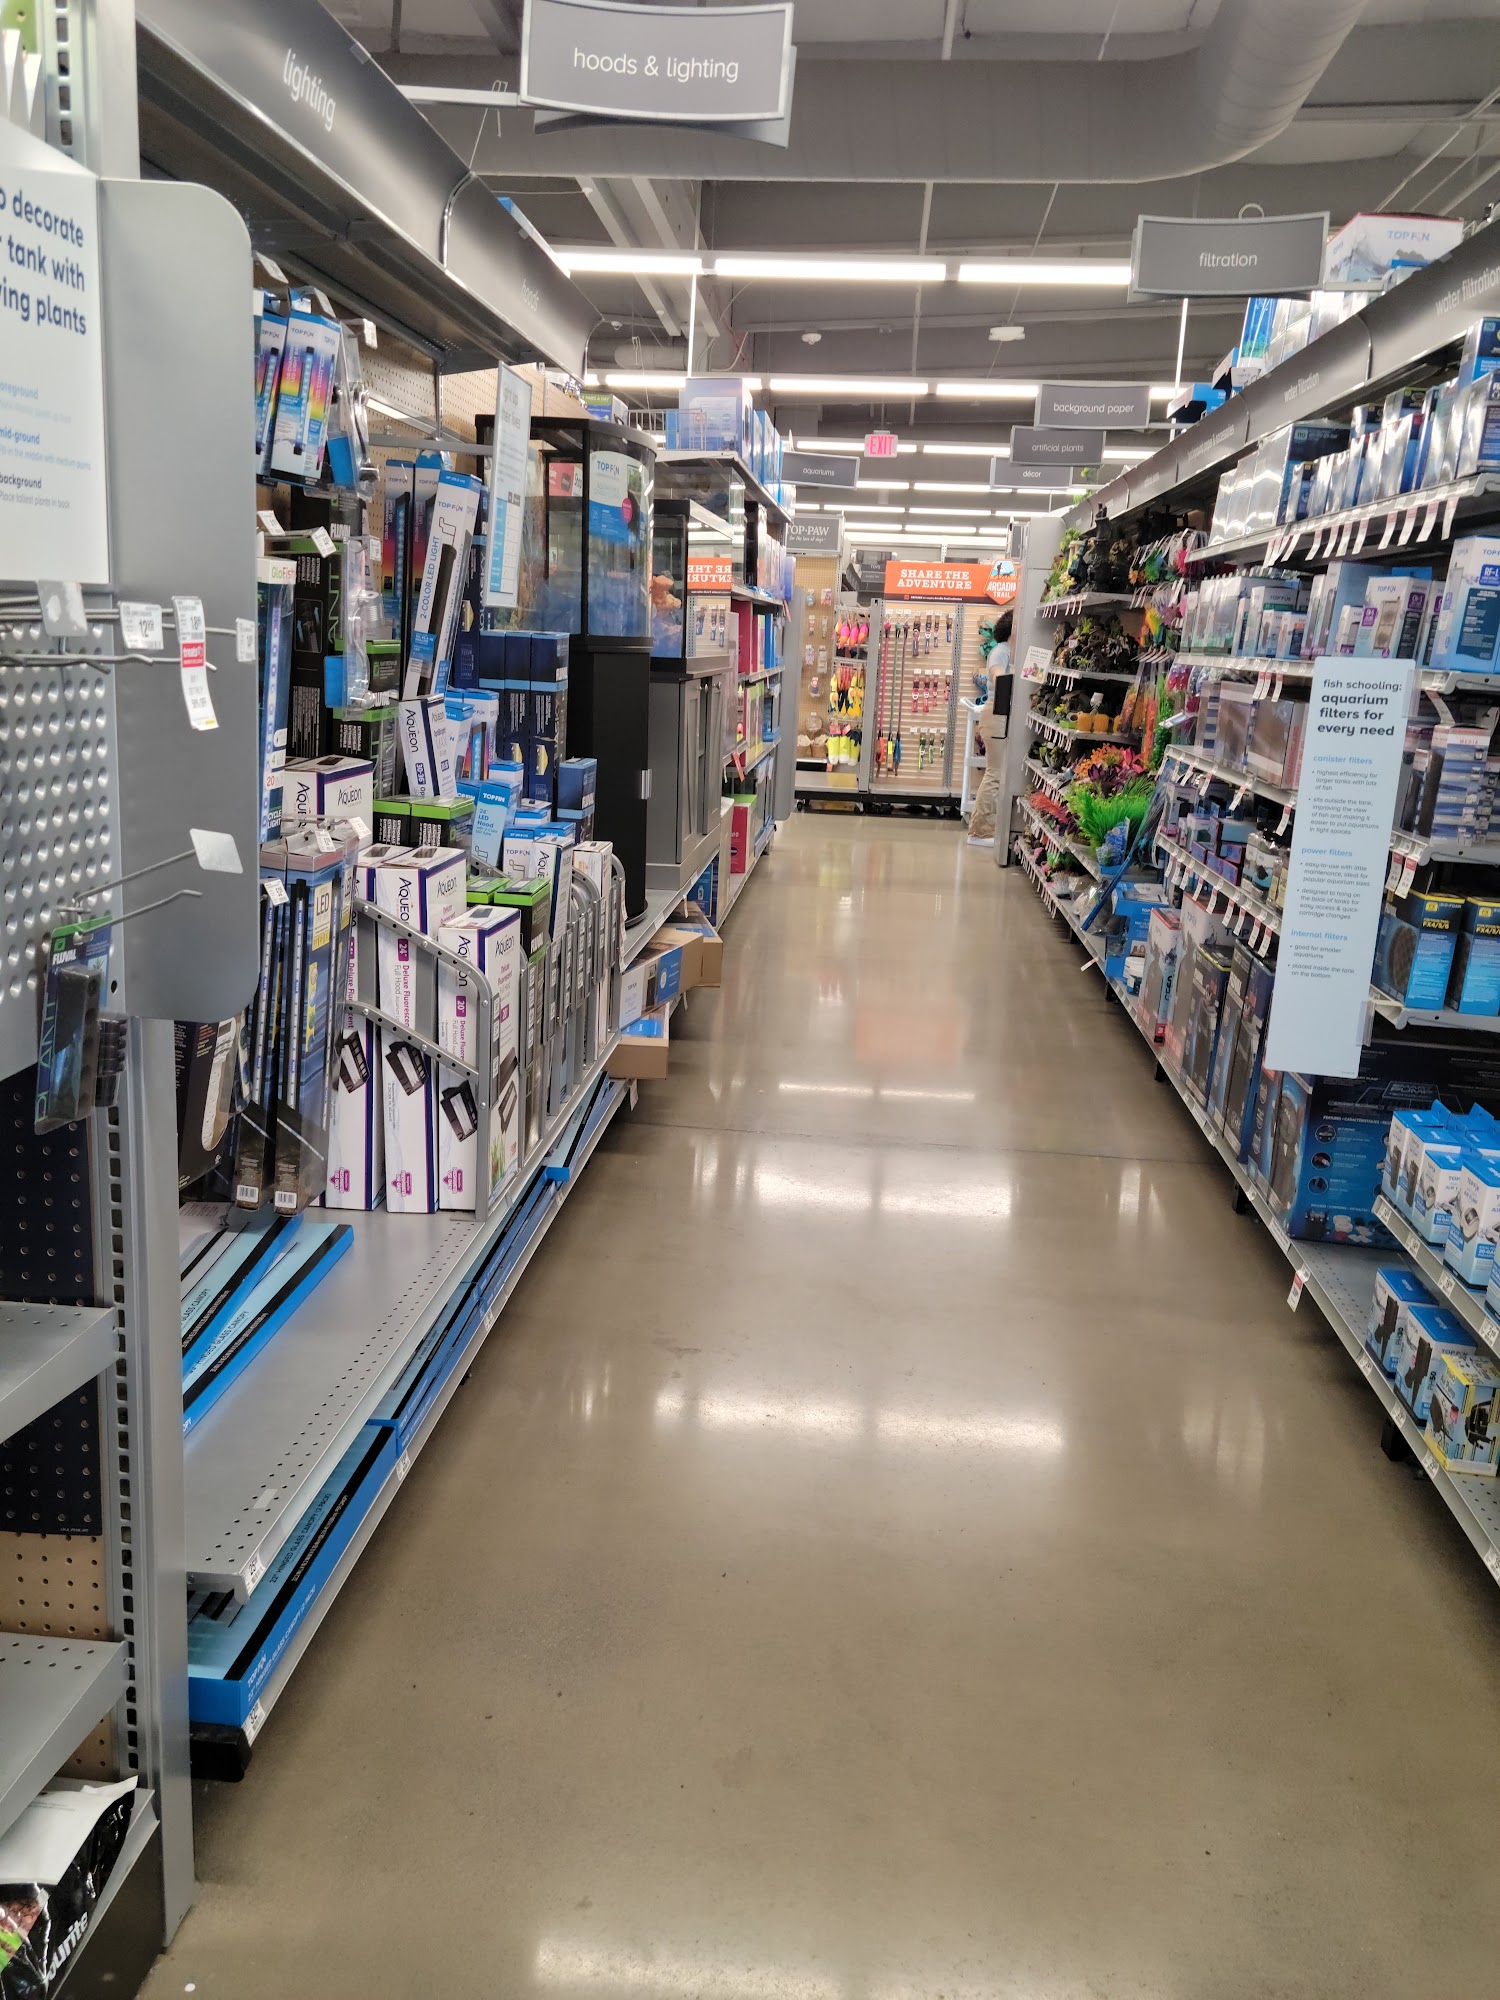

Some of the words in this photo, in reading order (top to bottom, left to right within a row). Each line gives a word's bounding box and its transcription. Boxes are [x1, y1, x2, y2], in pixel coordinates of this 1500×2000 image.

[573, 47, 637, 75] hoods
[645, 56, 659, 76] &
[666, 57, 739, 83] lighting
[283, 48, 336, 132] lighting
[13, 188, 84, 248] decorate
[8, 234, 47, 276] tank
[52, 256, 85, 292] with
[1199, 252, 1258, 268] filtration
[1435, 289, 1460, 316] water
[37, 294, 86, 335] plants
[0, 381, 39, 400] oreground
[1053, 403, 1105, 414] background
[1107, 404, 1134, 414] paper
[869, 435, 894, 456] EXIT
[1032, 444, 1060, 452] artificial
[1061, 444, 1084, 453] plants
[802, 465, 835, 477] aquariums
[1022, 468, 1042, 478] décor
[429, 536, 440, 562] LIGHT
[427, 563, 435, 580] LED
[901, 569, 942, 579] SHARE
[945, 570, 969, 580] THE
[897, 579, 972, 589] ADVENTURE
[420, 583, 433, 620] 2-COLOR
[1323, 679, 1342, 688] fish
[1346, 681, 1402, 692] schooling:
[1321, 694, 1388, 705] aquarium
[1320, 707, 1359, 719] filters
[1364, 709, 1384, 720] for
[1318, 724, 1355, 736] every
[1360, 726, 1395, 736] need
[1313, 755, 1346, 763] canister
[266, 775, 275, 786] 20
[268, 809, 282, 820] CYCLE
[1301, 847, 1327, 855] power
[1329, 848, 1353, 857] filters
[1305, 861, 1339, 869] easy-to-use
[1302, 887, 1328, 895] designed
[1337, 890, 1352, 898] hang
[316, 893, 329, 916] LED
[1291, 929, 1322, 939] internal
[1325, 932, 1348, 941] filters
[52, 949, 77, 966] FLUVAL
